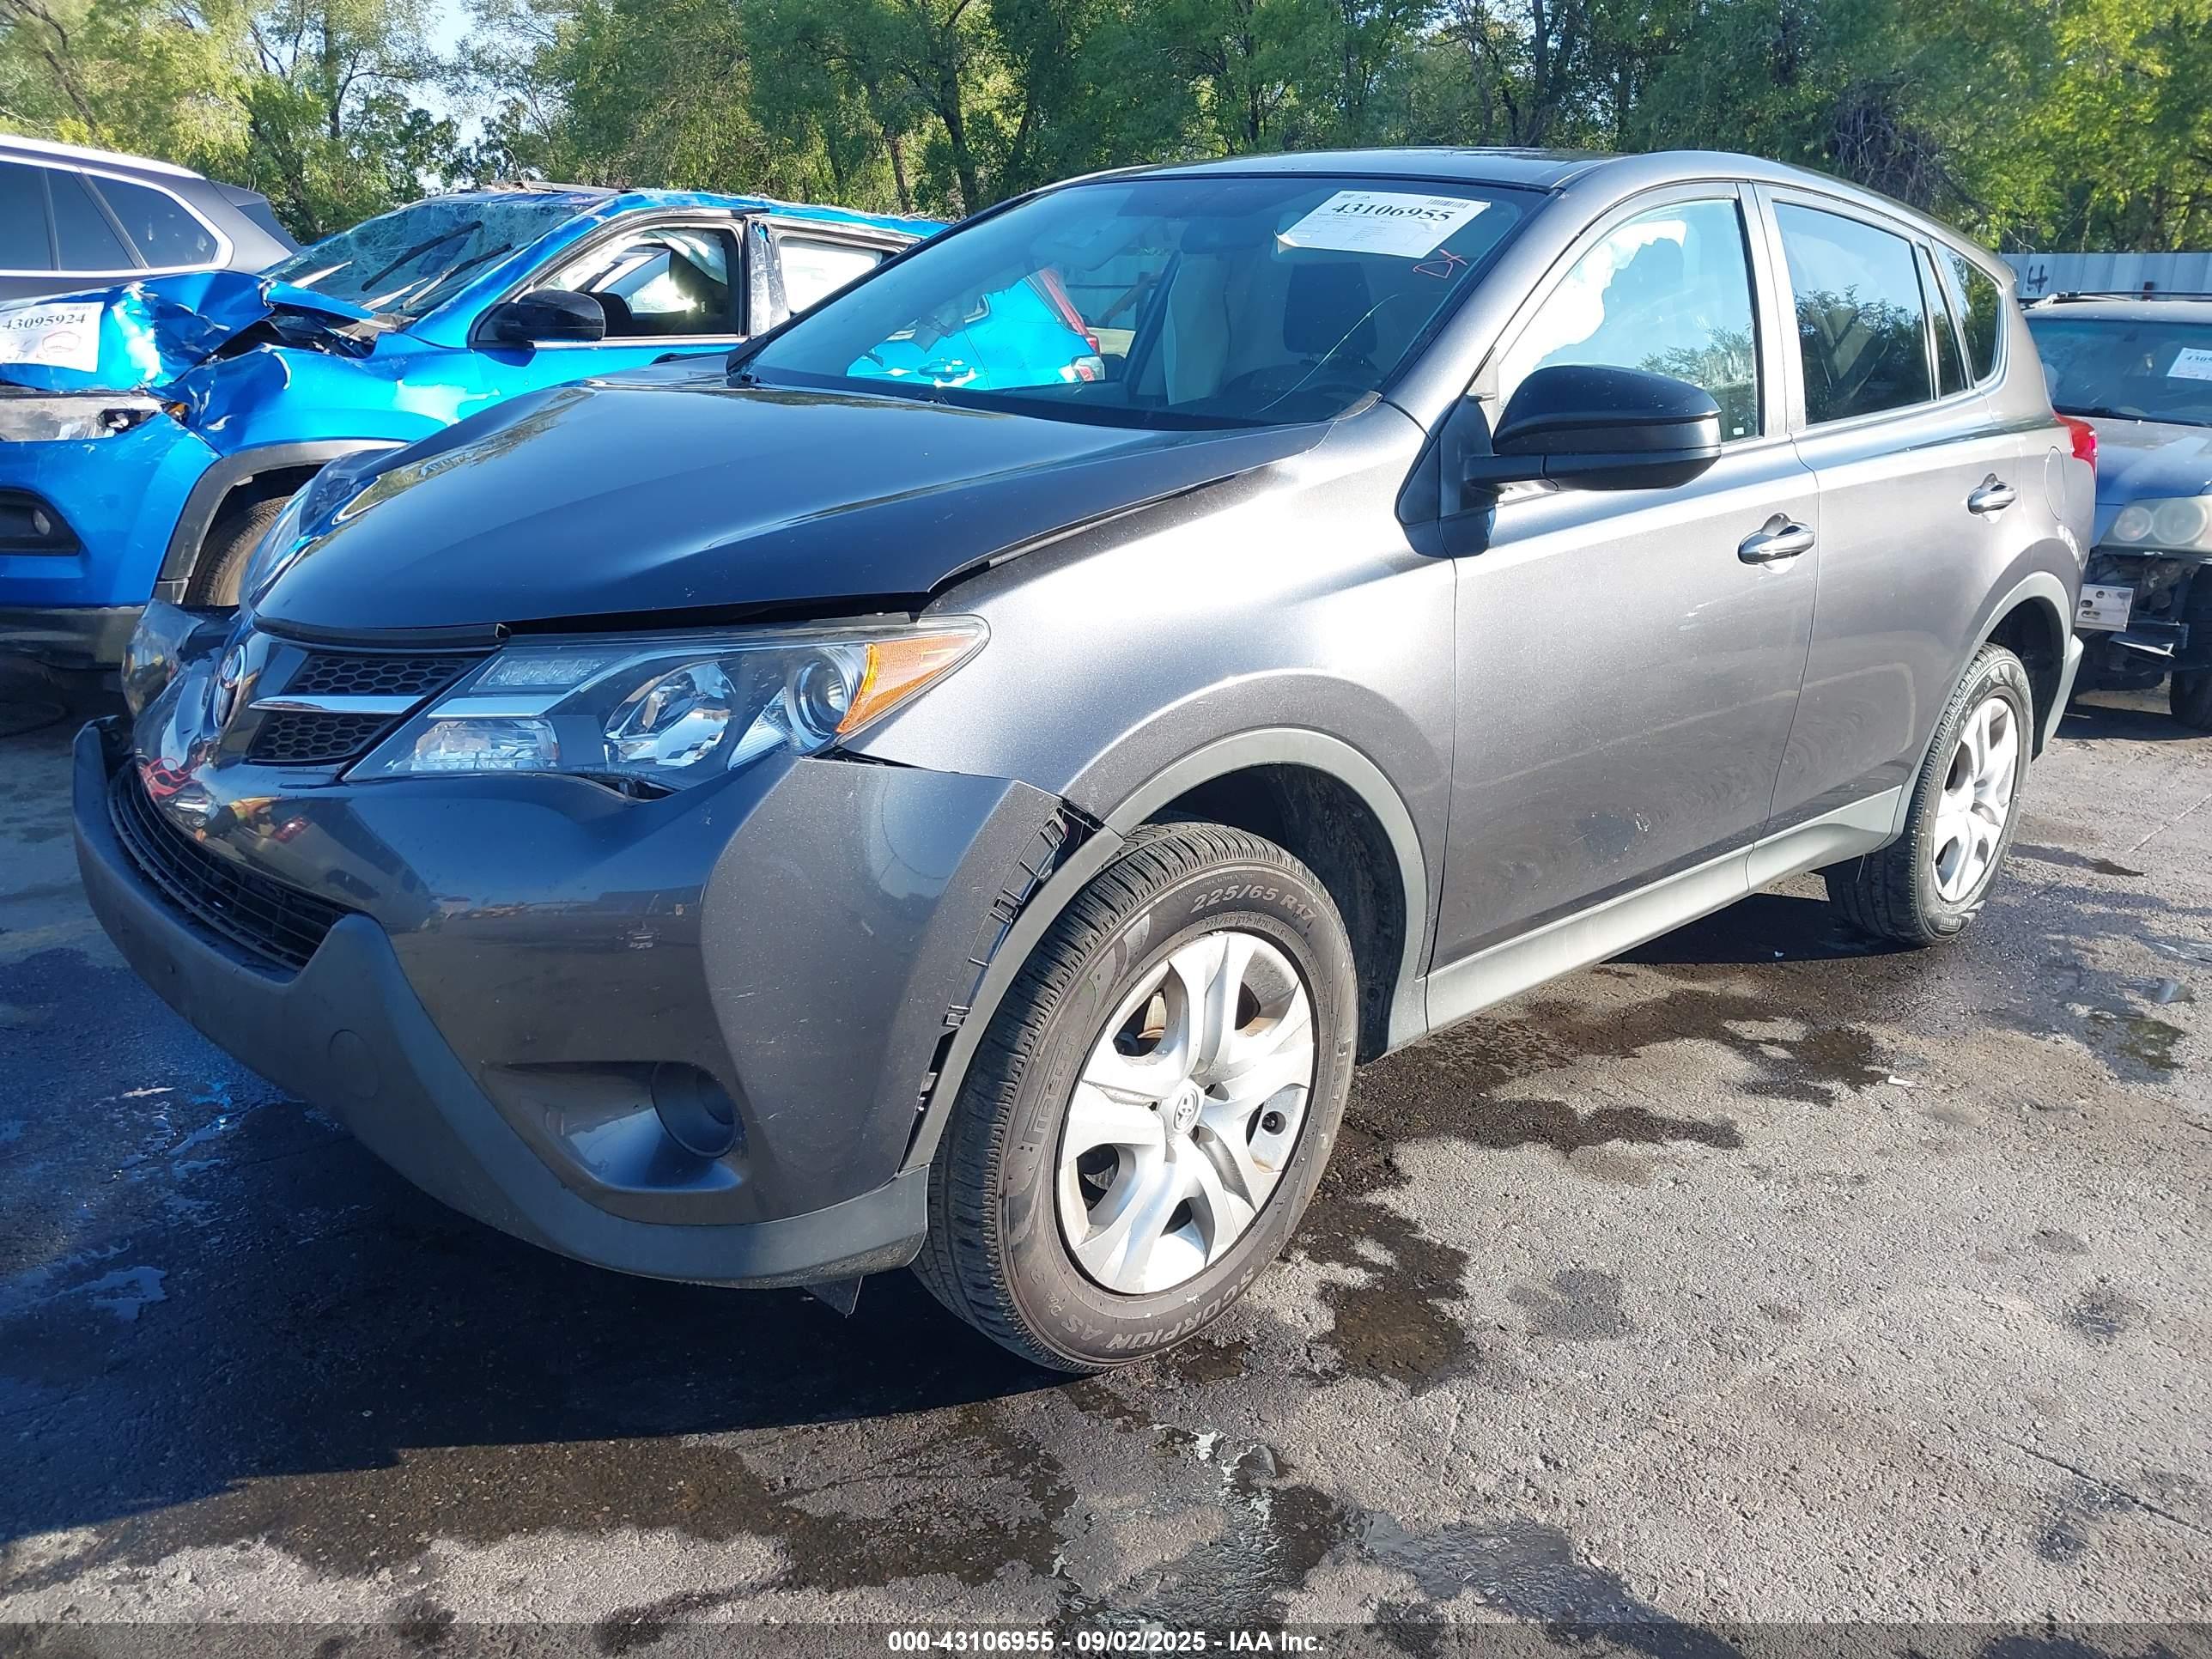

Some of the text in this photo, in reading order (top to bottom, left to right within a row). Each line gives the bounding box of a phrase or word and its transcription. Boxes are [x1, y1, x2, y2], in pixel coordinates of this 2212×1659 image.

[1332, 202, 1456, 222] 43106955
[3, 313, 86, 330] 43095924
[1189, 884, 1279, 914] 225/65
[1279, 893, 1318, 921] R17
[1105, 1264, 1255, 1350] SCORPION
[1060, 1314, 1104, 1341] AS
